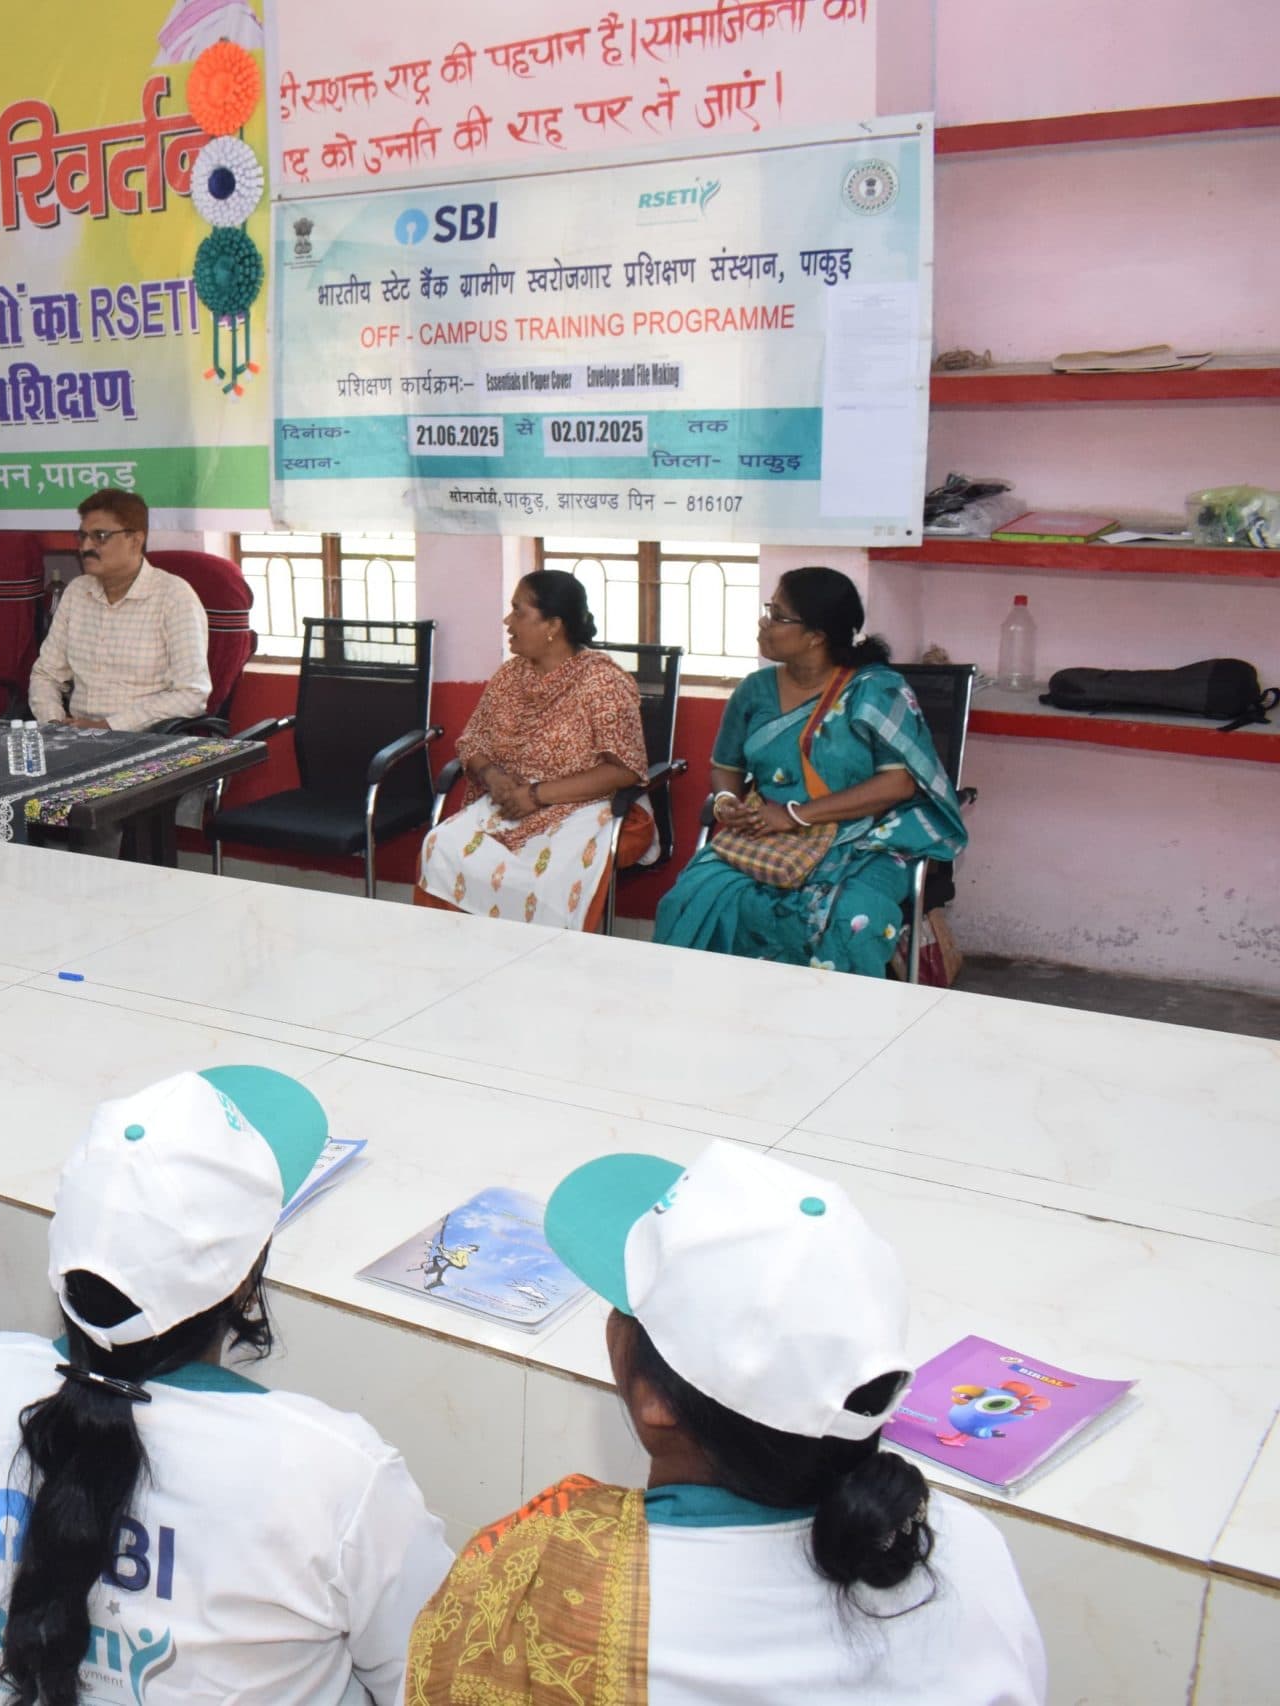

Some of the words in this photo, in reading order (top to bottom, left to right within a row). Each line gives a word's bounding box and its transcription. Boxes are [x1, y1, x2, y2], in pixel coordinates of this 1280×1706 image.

[440, 42, 476, 84] की
[484, 27, 591, 78] पहचान
[321, 133, 357, 169] को
[453, 104, 493, 153] की
[507, 108, 567, 150] राह
[574, 95, 633, 134] पर
[642, 77, 680, 134] ले
[638, 187, 697, 209] RSETI
[433, 202, 498, 243] SBI
[318, 273, 372, 305] भारतीय
[381, 270, 411, 302] स्टेट
[420, 266, 449, 299] बैंक
[460, 263, 515, 298] ग्रामीण
[527, 257, 612, 293] स्वरोजगार
[624, 251, 695, 287] प्रशिक्षण
[30, 293, 83, 344] का
[89, 278, 199, 340] RSETI
[360, 325, 401, 348] OFF
[420, 319, 508, 345] CAMPUS
[515, 312, 624, 341] TRAINING
[633, 304, 795, 335] PROGRAMME
[337, 372, 391, 398] प्रशिक्षण
[530, 371, 550, 392] Paper
[551, 370, 572, 390] Cover
[587, 365, 619, 389] Envelope
[621, 365, 635, 387] and
[636, 364, 650, 387] File
[652, 363, 679, 388] Making
[416, 425, 499, 447] 21.06.2025
[515, 418, 535, 436] से
[551, 420, 643, 442] 02.07.2025
[687, 418, 728, 433] तक
[557, 492, 618, 511] झारखण्ड
[628, 488, 656, 511] पिन
[687, 496, 743, 513] 816107
[102, 1516, 175, 1600] BI
